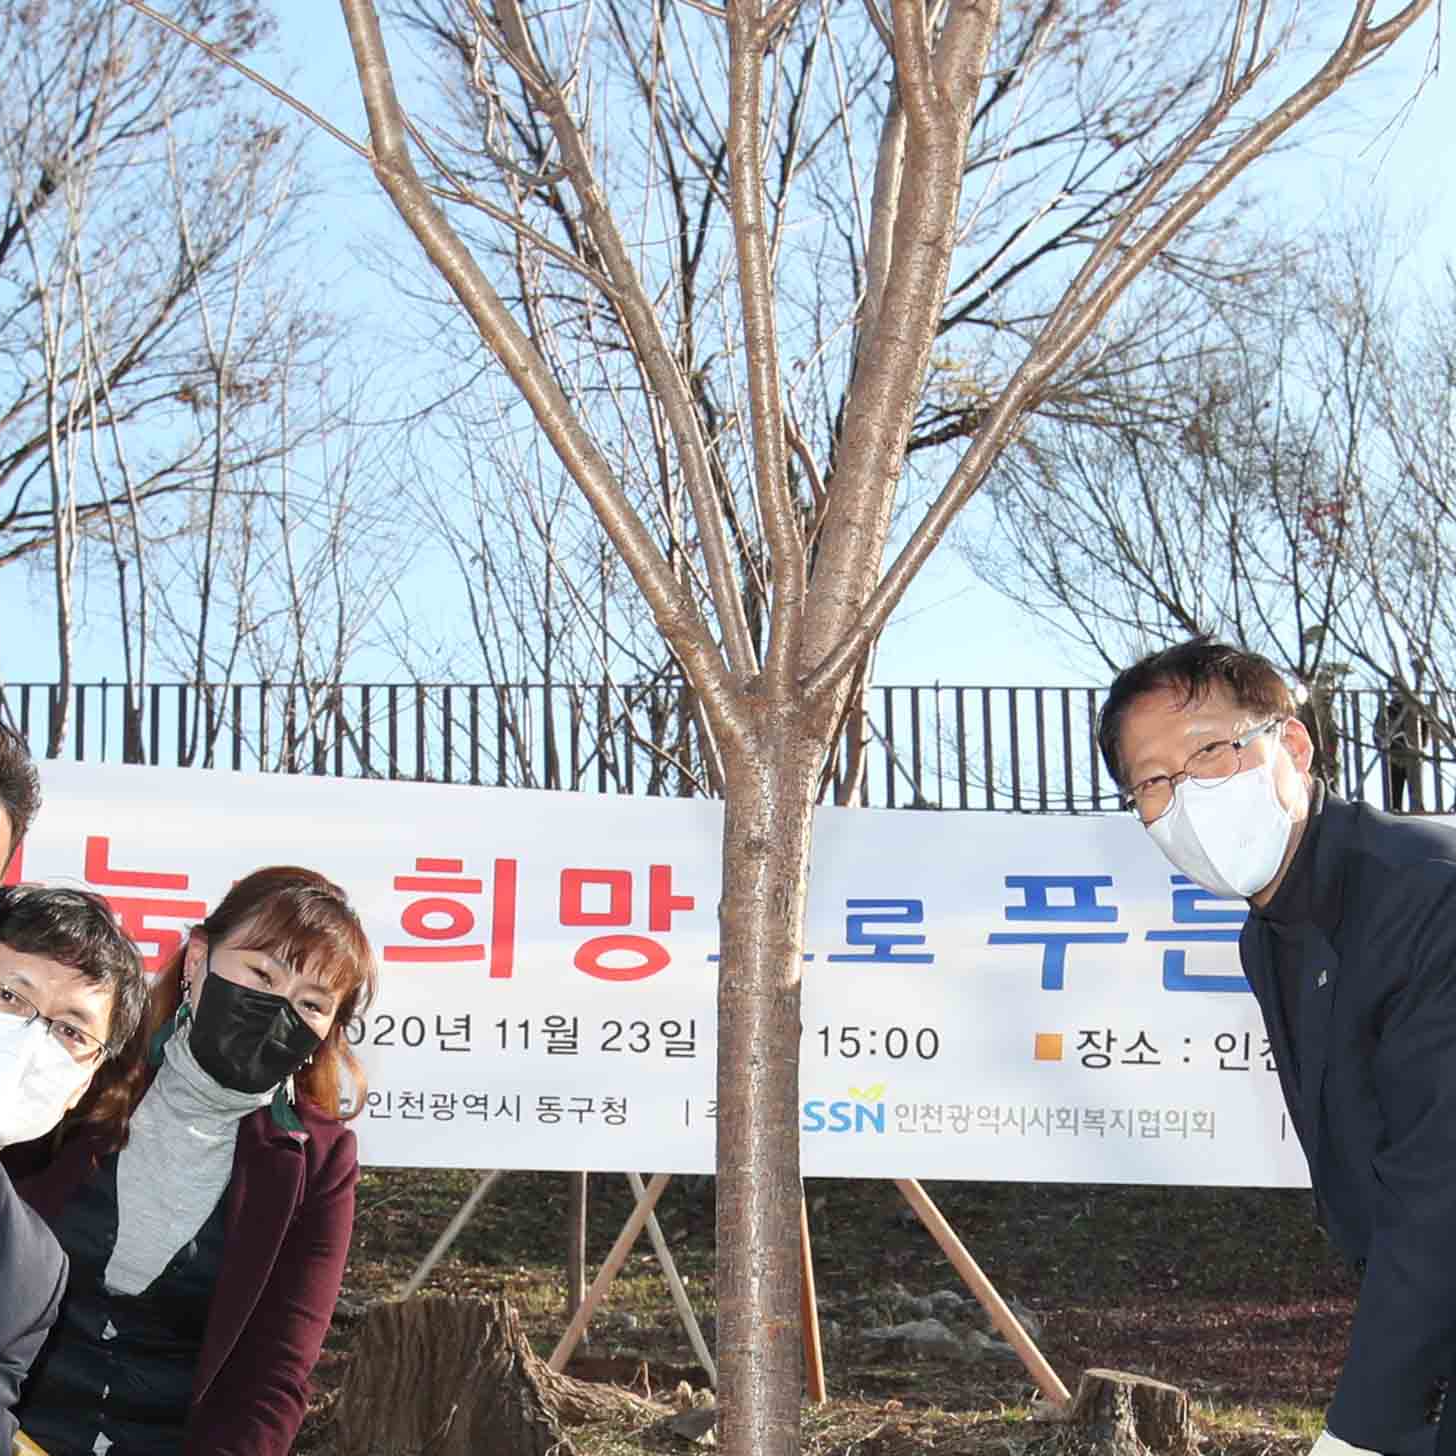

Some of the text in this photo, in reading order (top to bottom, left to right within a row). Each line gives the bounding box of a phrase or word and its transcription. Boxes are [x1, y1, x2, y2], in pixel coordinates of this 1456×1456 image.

[384, 857, 935, 981] 희망로
[344, 1014, 939, 1060] 020년 11월 23일 15:00
[1076, 1029, 1161, 1069] 장소
[366, 1091, 521, 1124] 인천광역시
[535, 1096, 627, 1126] 동구청
[802, 1101, 885, 1134] SSN
